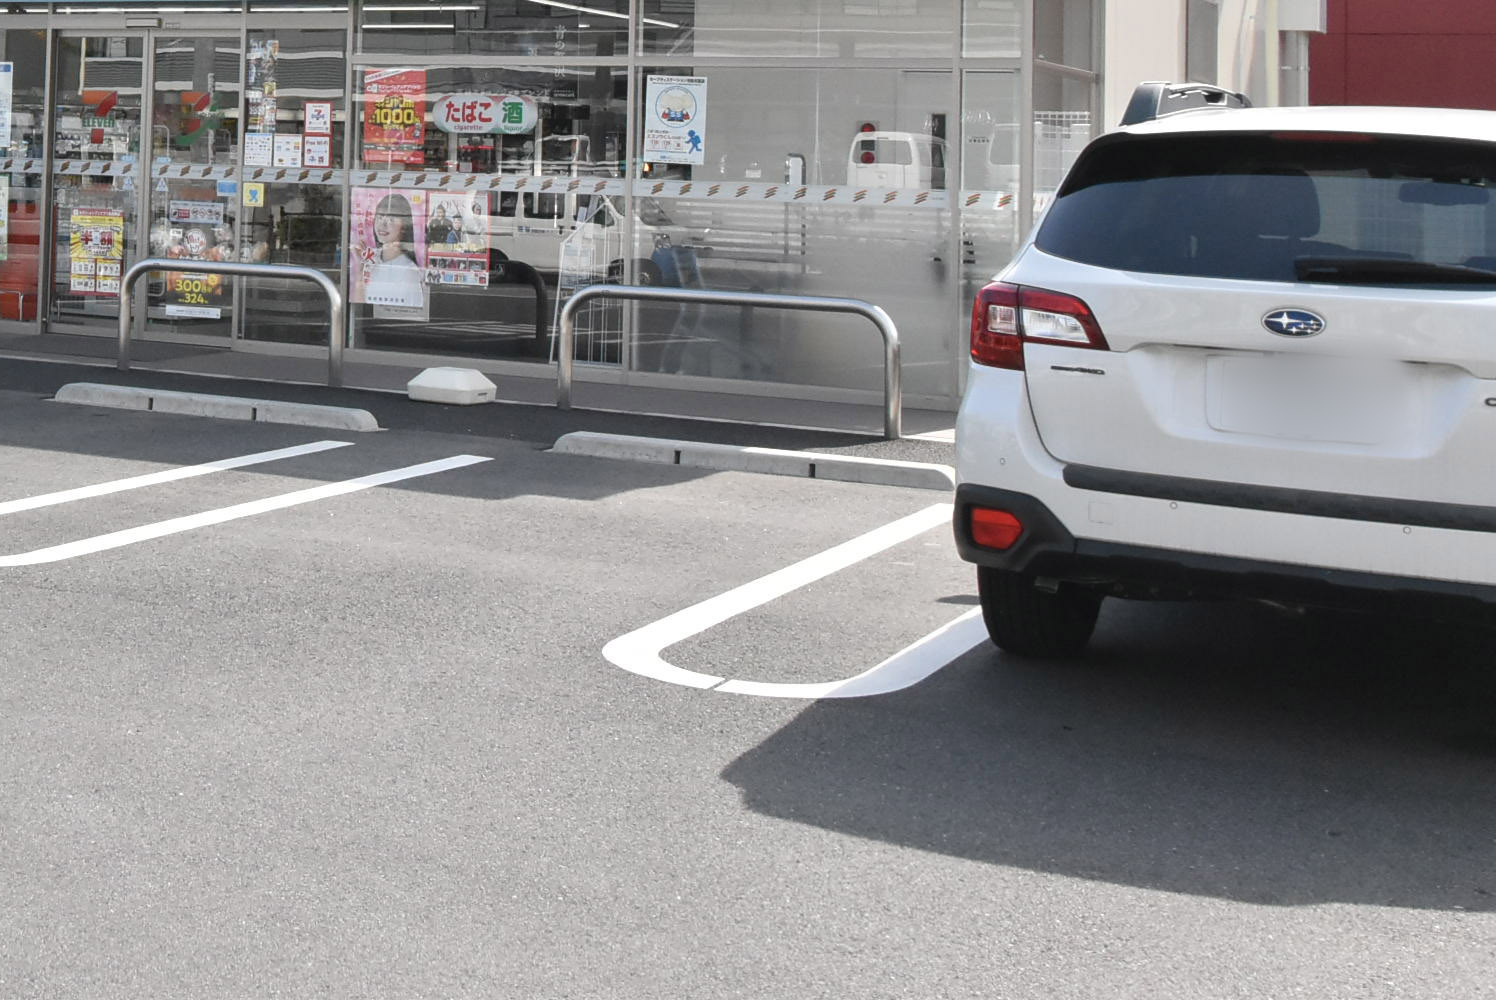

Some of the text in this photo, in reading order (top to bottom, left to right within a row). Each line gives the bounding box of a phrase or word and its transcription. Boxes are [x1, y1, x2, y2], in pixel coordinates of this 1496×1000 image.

[445, 101, 493, 123] たばこ
[502, 101, 523, 124] 酒
